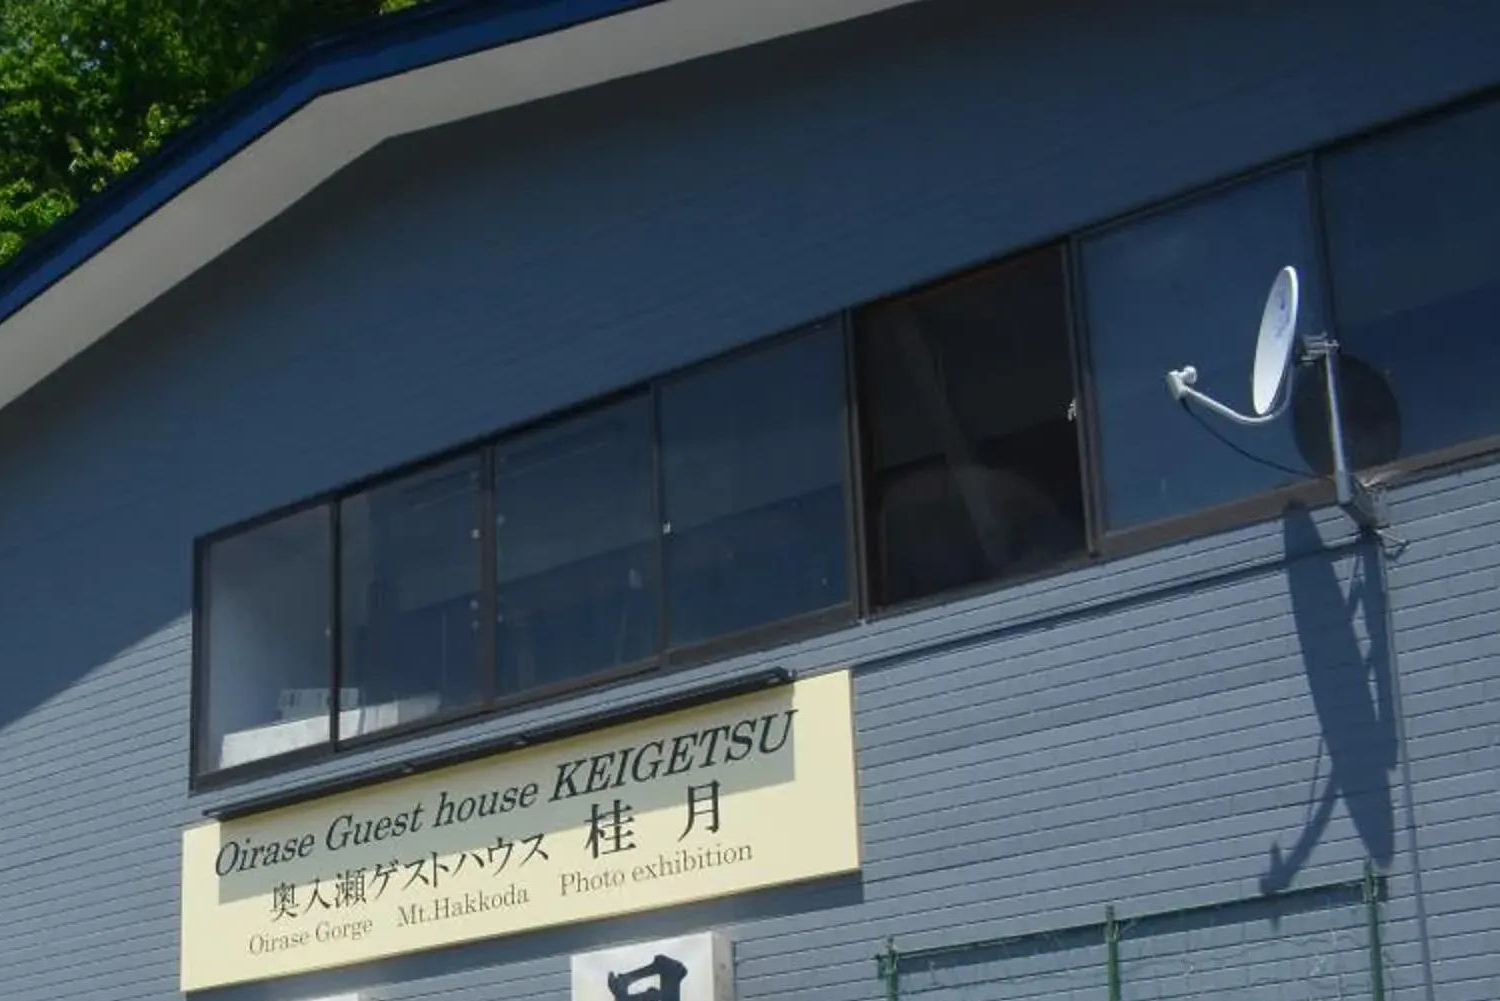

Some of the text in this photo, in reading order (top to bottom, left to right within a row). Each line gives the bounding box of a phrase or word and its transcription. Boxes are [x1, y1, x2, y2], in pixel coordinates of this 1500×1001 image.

[215, 708, 799, 877] Oirase Guest house KEIGETSU
[269, 778, 721, 922] 奥入瀬ゲストハウス 桂 月
[248, 843, 753, 955] Oirase Gorge Mt.Hakkoda Photo exhibition
